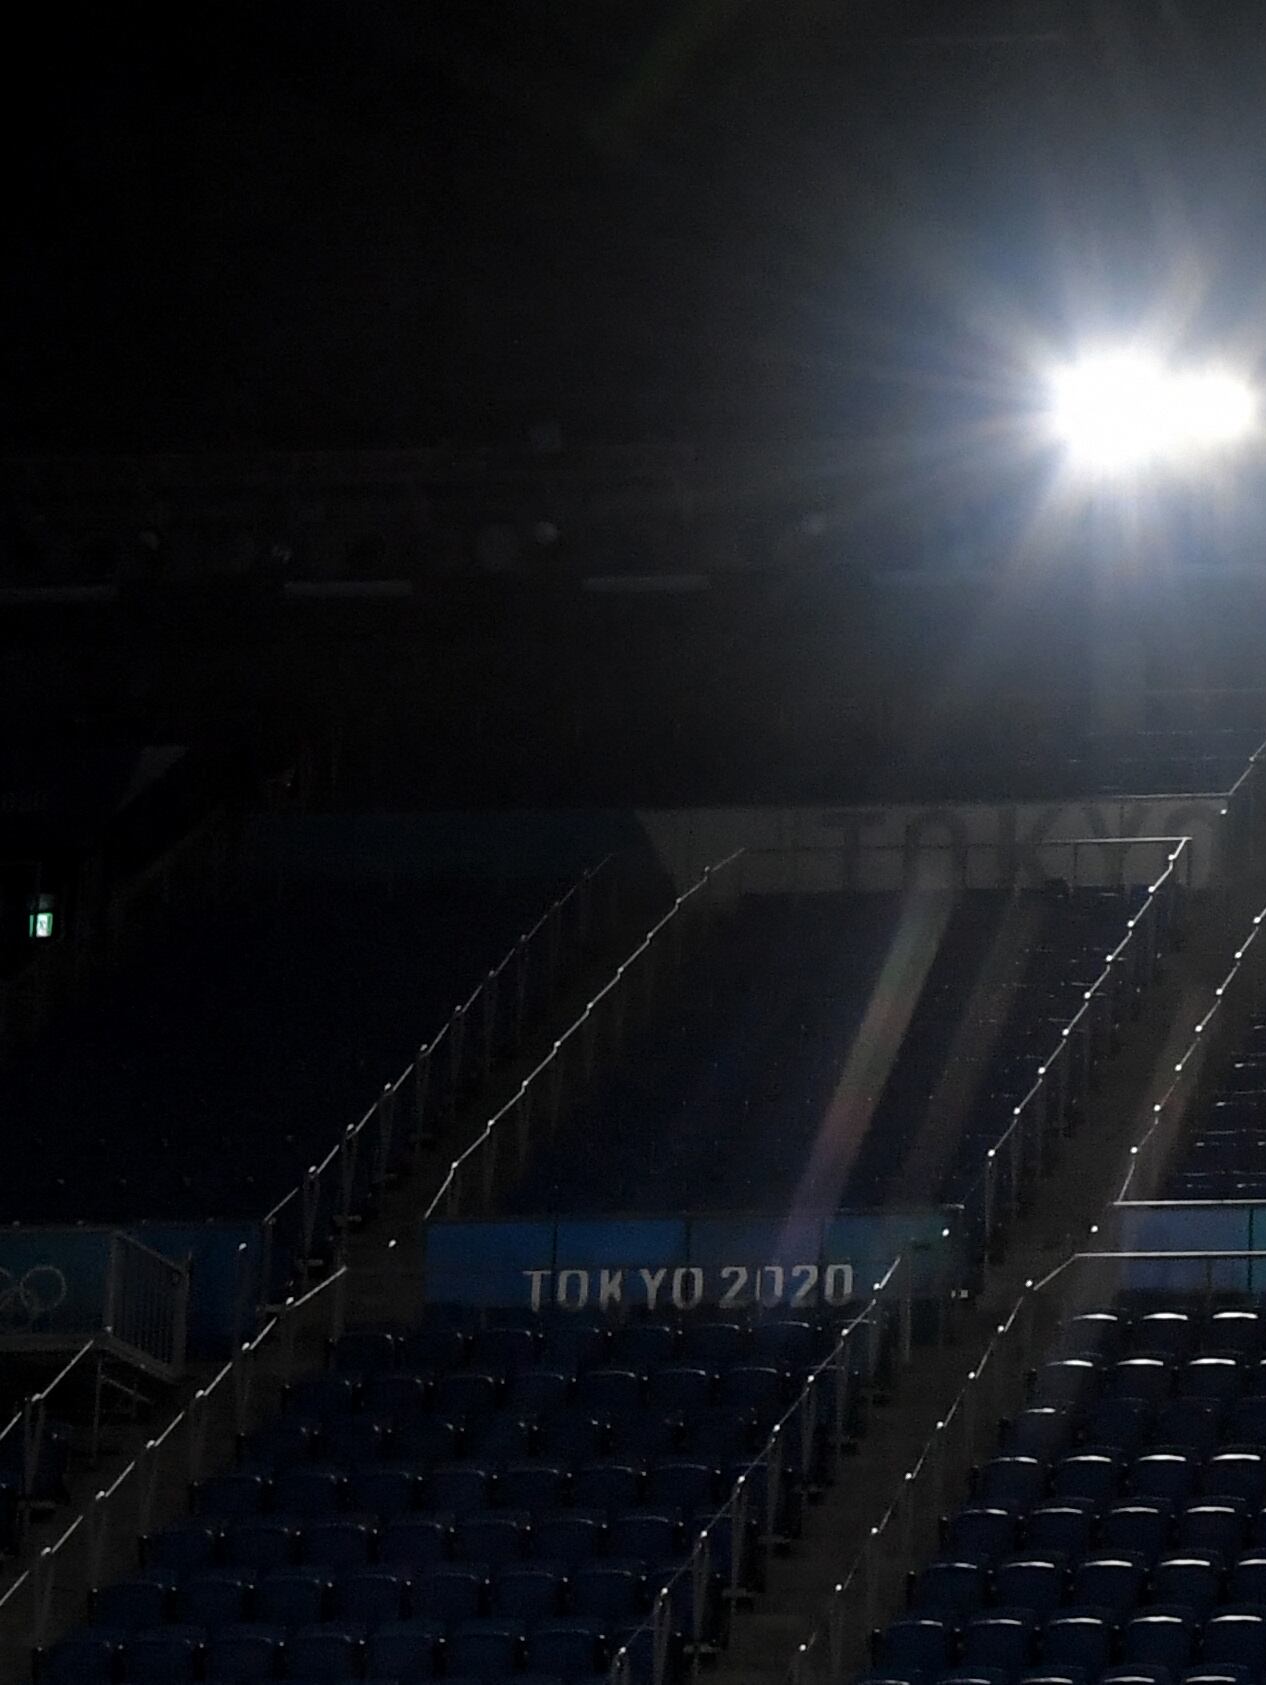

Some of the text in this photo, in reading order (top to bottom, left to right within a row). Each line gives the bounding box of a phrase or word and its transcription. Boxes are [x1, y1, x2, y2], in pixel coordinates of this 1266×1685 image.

[821, 804, 1222, 888] TOKYO
[522, 1263, 854, 1311] TOKYO 2020
